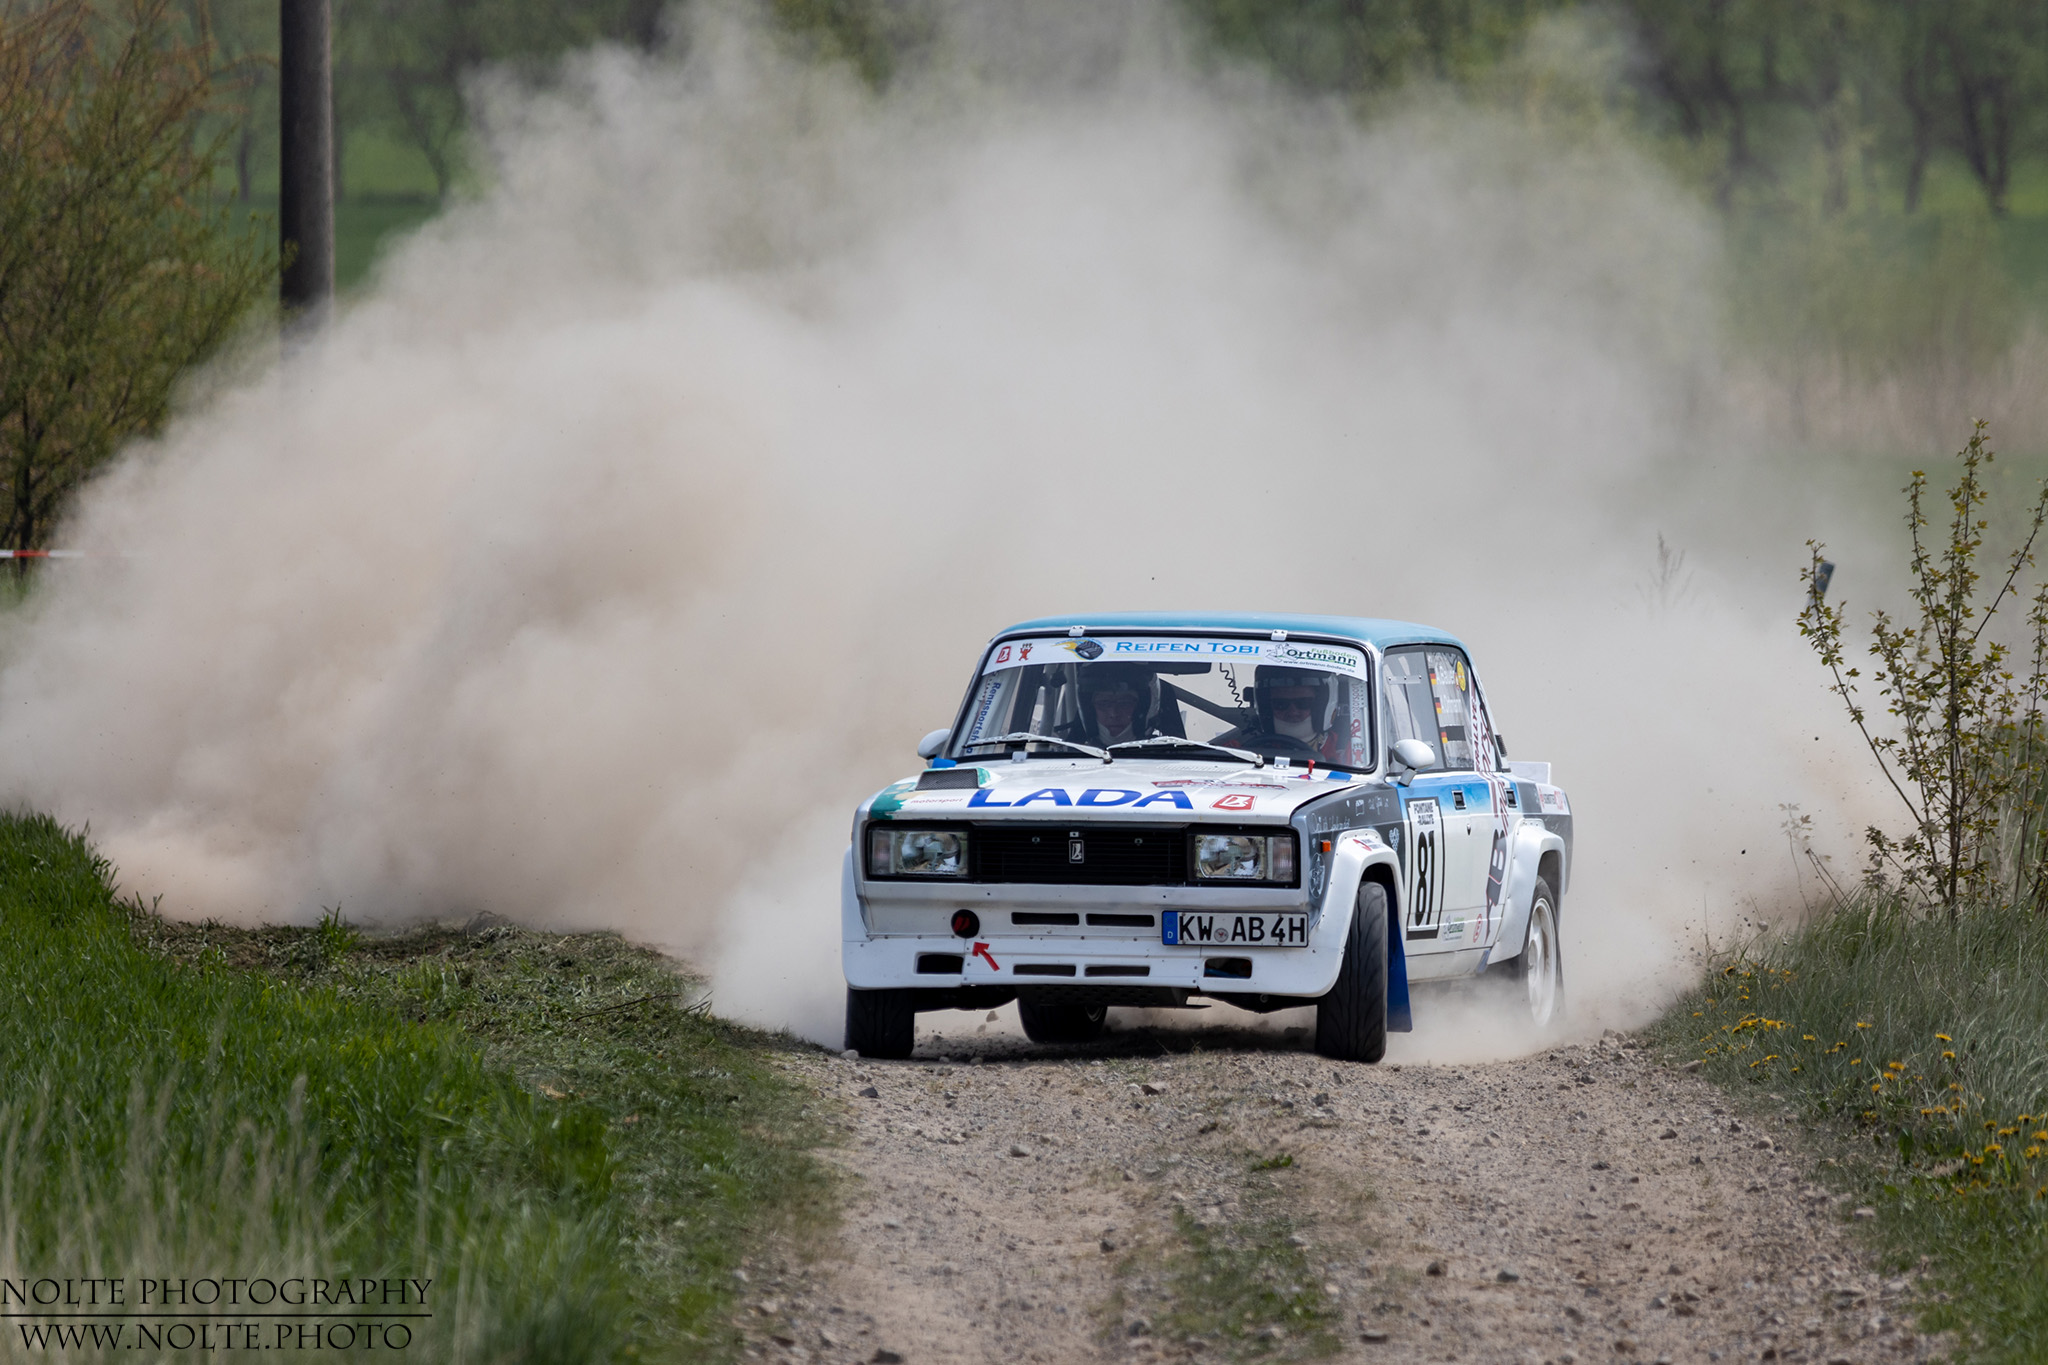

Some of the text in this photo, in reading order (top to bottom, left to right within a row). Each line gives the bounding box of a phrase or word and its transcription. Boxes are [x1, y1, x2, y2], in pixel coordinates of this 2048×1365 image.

[1286, 648, 1357, 666] Ortmann
[966, 682, 1001, 754] Rennsportshp
[910, 797, 963, 805] motorsport
[966, 788, 1194, 809] LADA
[1415, 830, 1435, 927] 81
[1167, 930, 1174, 939] D
[1179, 916, 1305, 943] KW AB 4H
